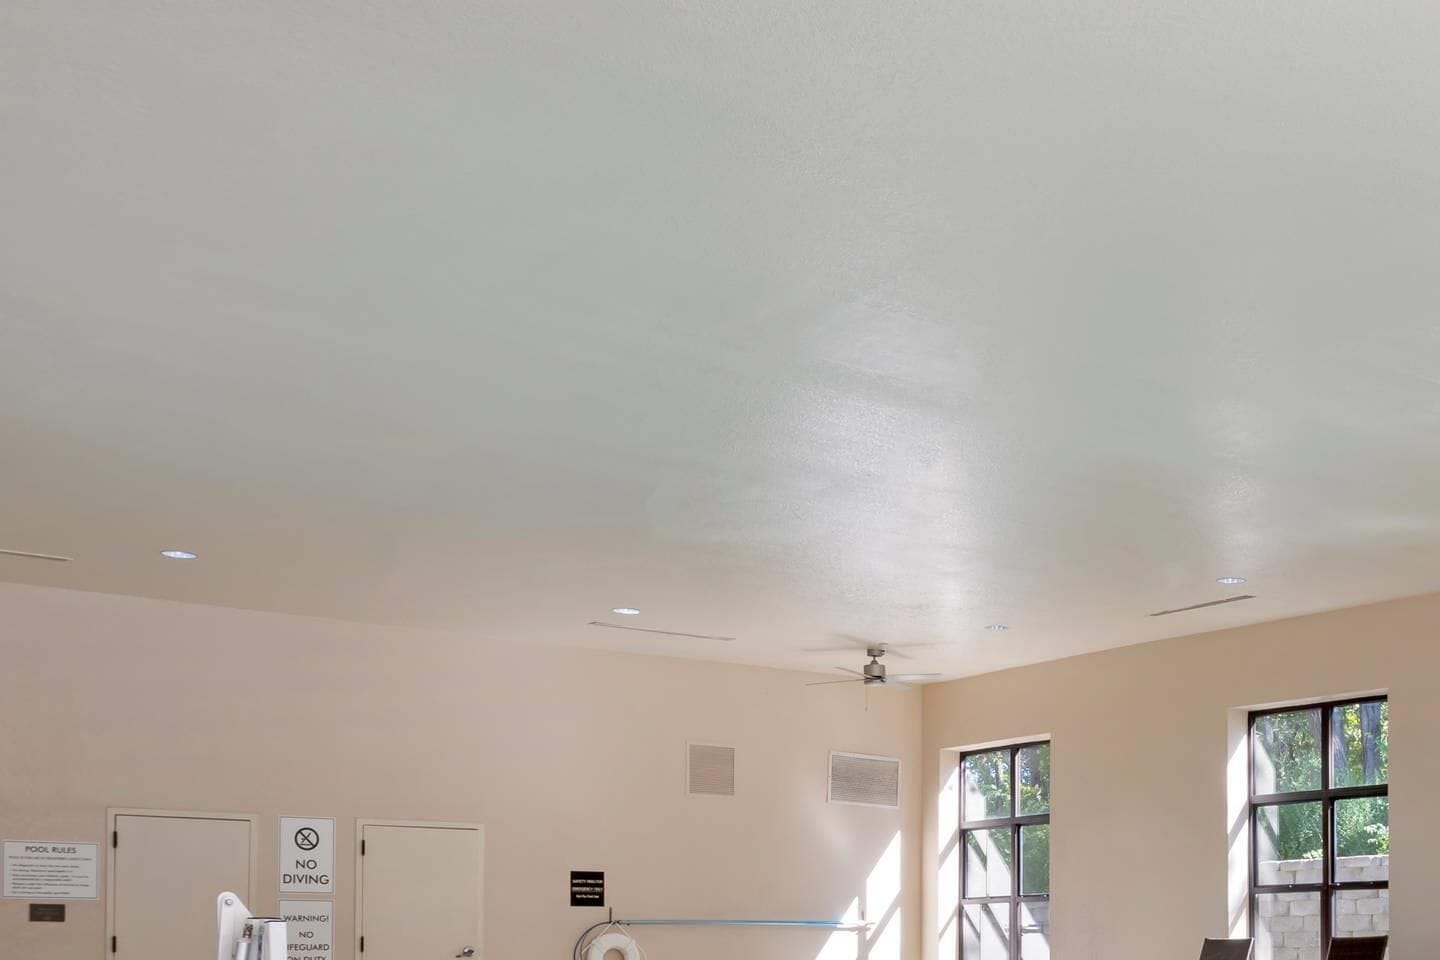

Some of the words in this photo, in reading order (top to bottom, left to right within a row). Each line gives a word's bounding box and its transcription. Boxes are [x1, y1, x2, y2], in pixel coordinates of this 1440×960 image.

[52, 846, 76, 854] RULES
[296, 860, 317, 870] NO
[283, 874, 329, 885] DIVING
[283, 914, 329, 922] WARNING!
